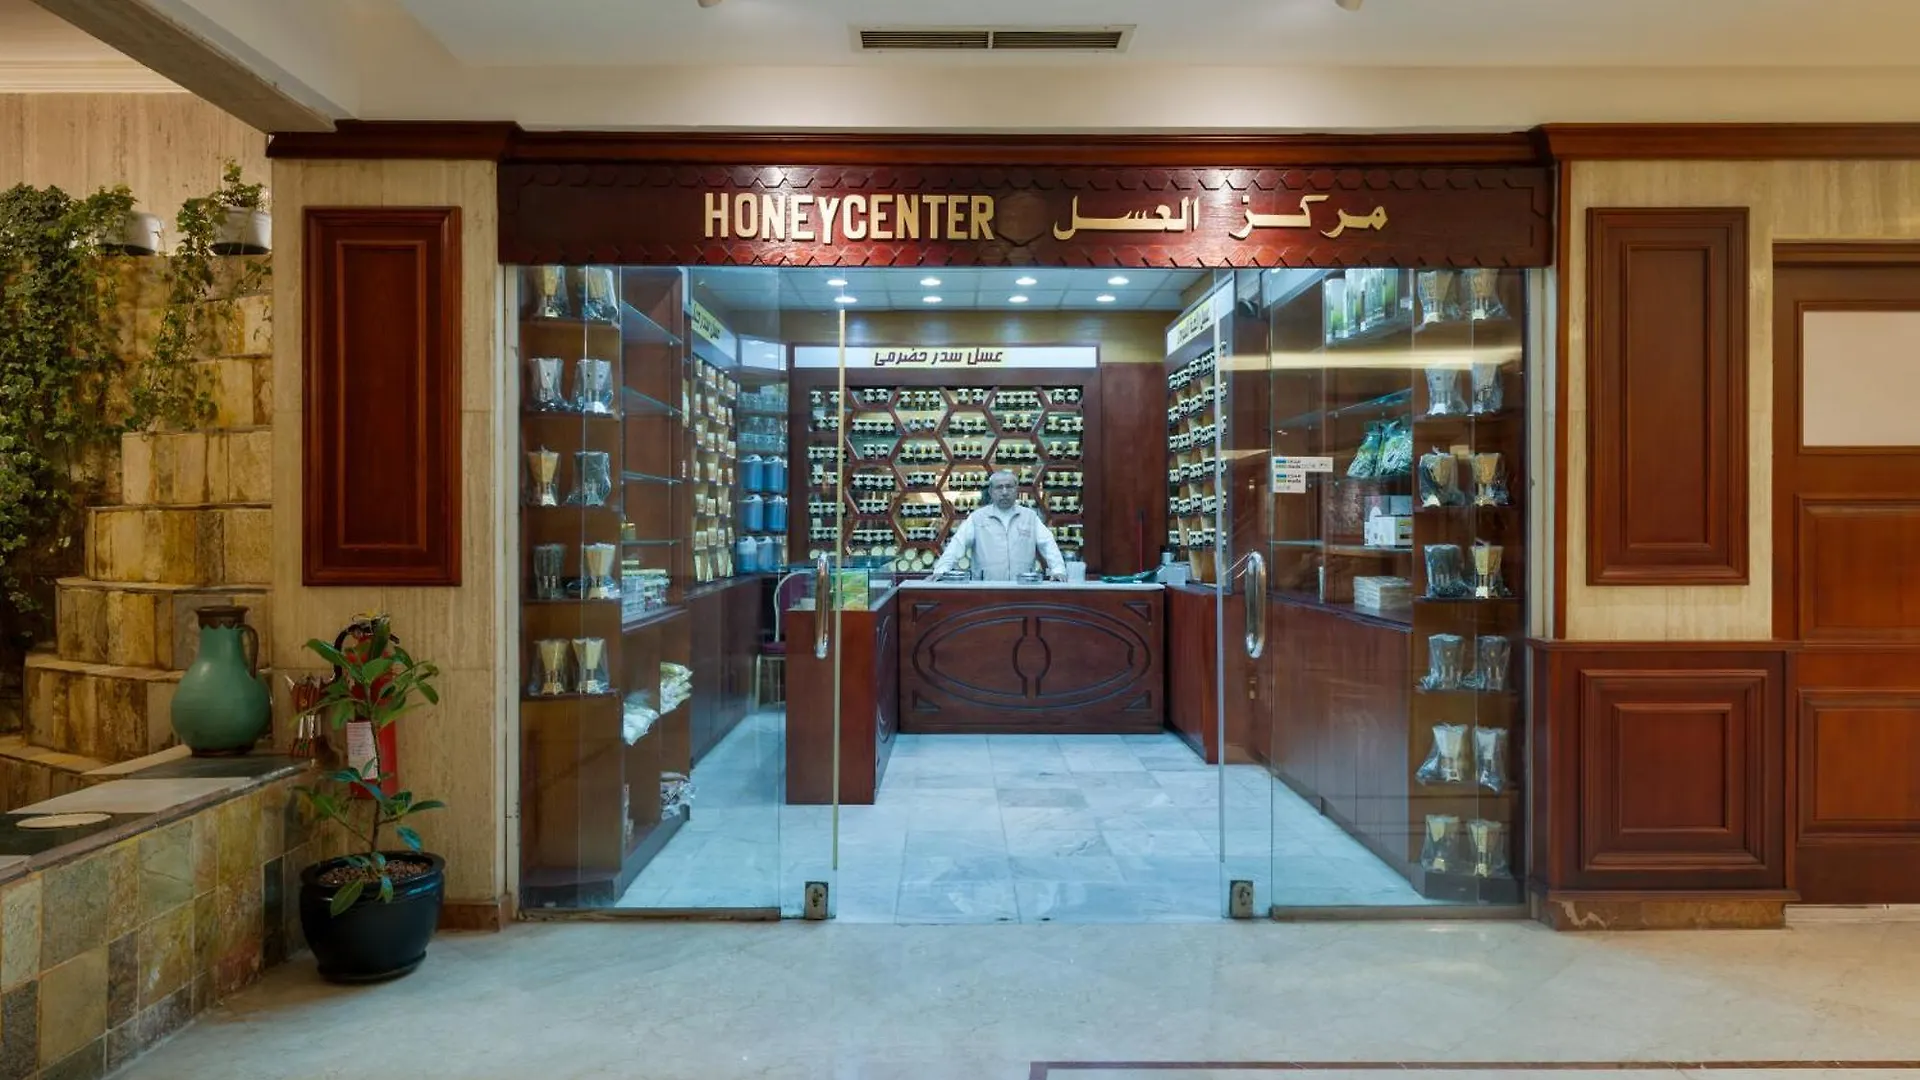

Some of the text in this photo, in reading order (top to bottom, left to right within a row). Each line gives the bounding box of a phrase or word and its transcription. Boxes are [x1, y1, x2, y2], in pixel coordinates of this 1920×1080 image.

[1053, 194, 1389, 241] مركز العسل
[931, 350, 963, 366] سدر
[967, 347, 1003, 366] عسل
